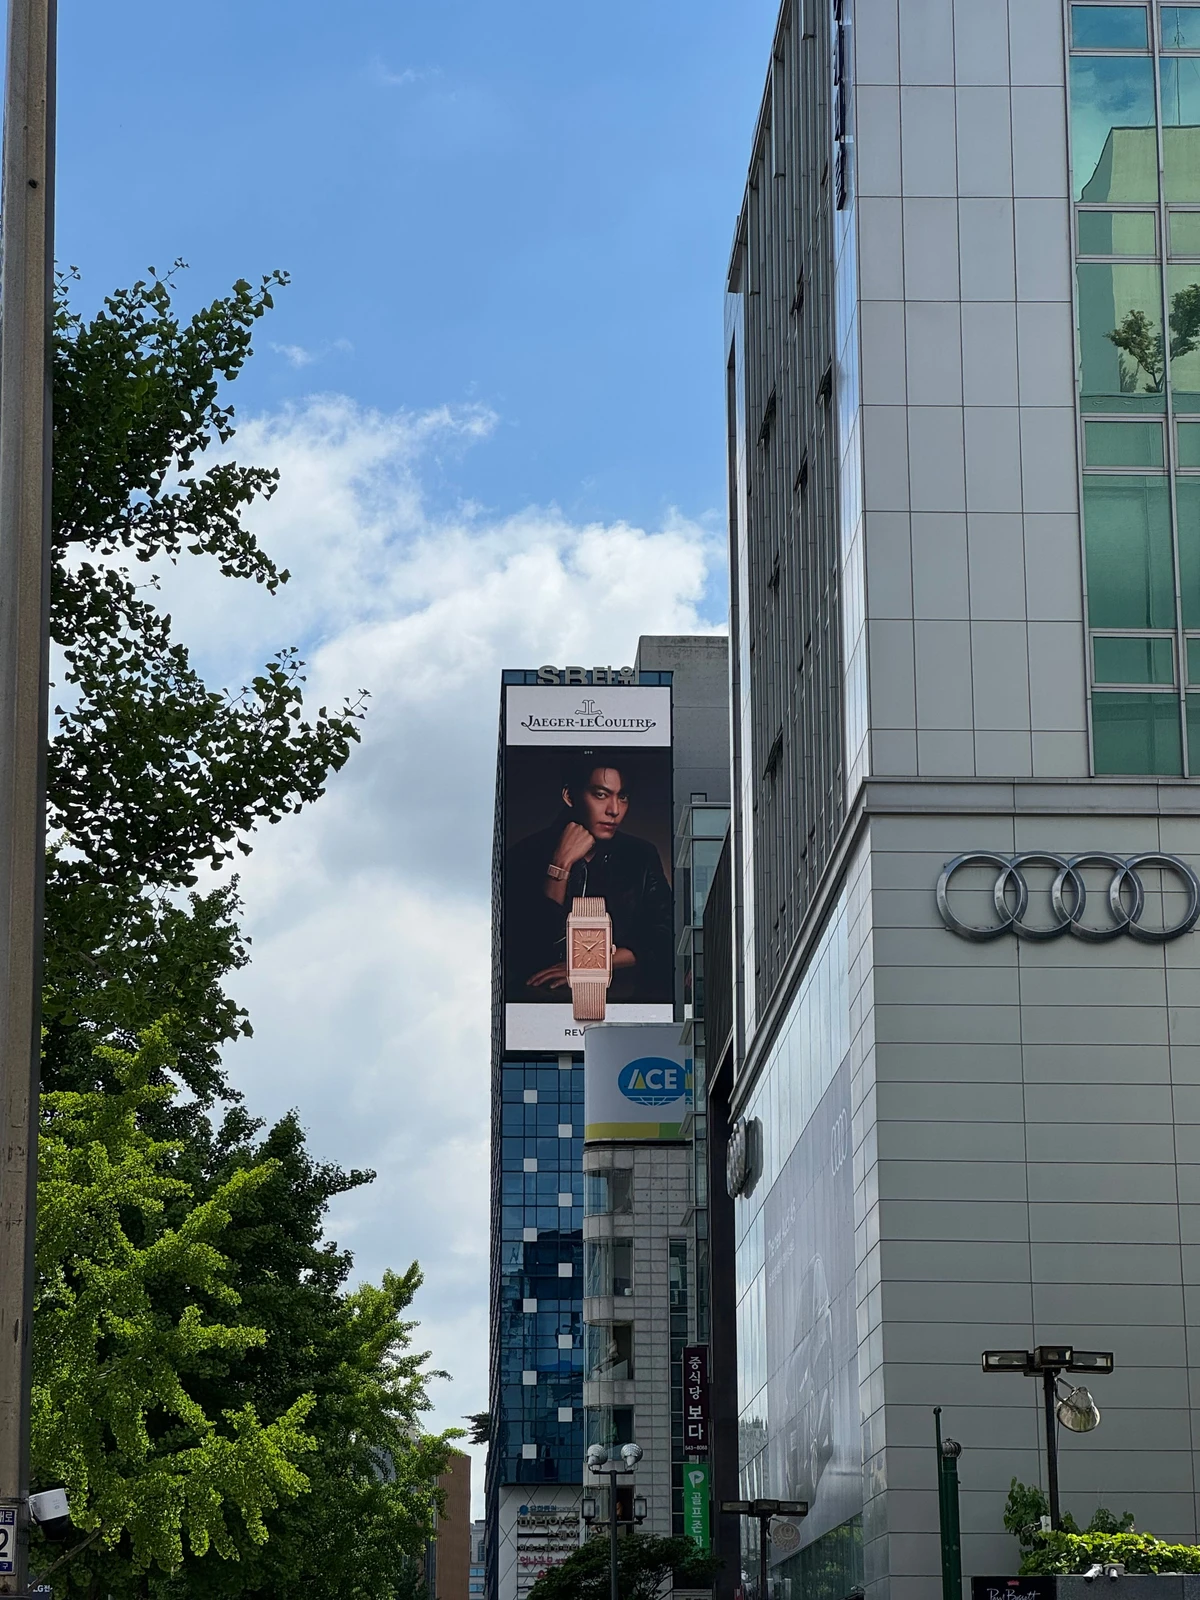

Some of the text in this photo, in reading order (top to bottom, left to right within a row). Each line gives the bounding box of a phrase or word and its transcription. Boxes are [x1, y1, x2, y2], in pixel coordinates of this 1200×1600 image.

[627, 1068, 677, 1090] ACE
[687, 1356, 704, 1440] 중식당 보다
